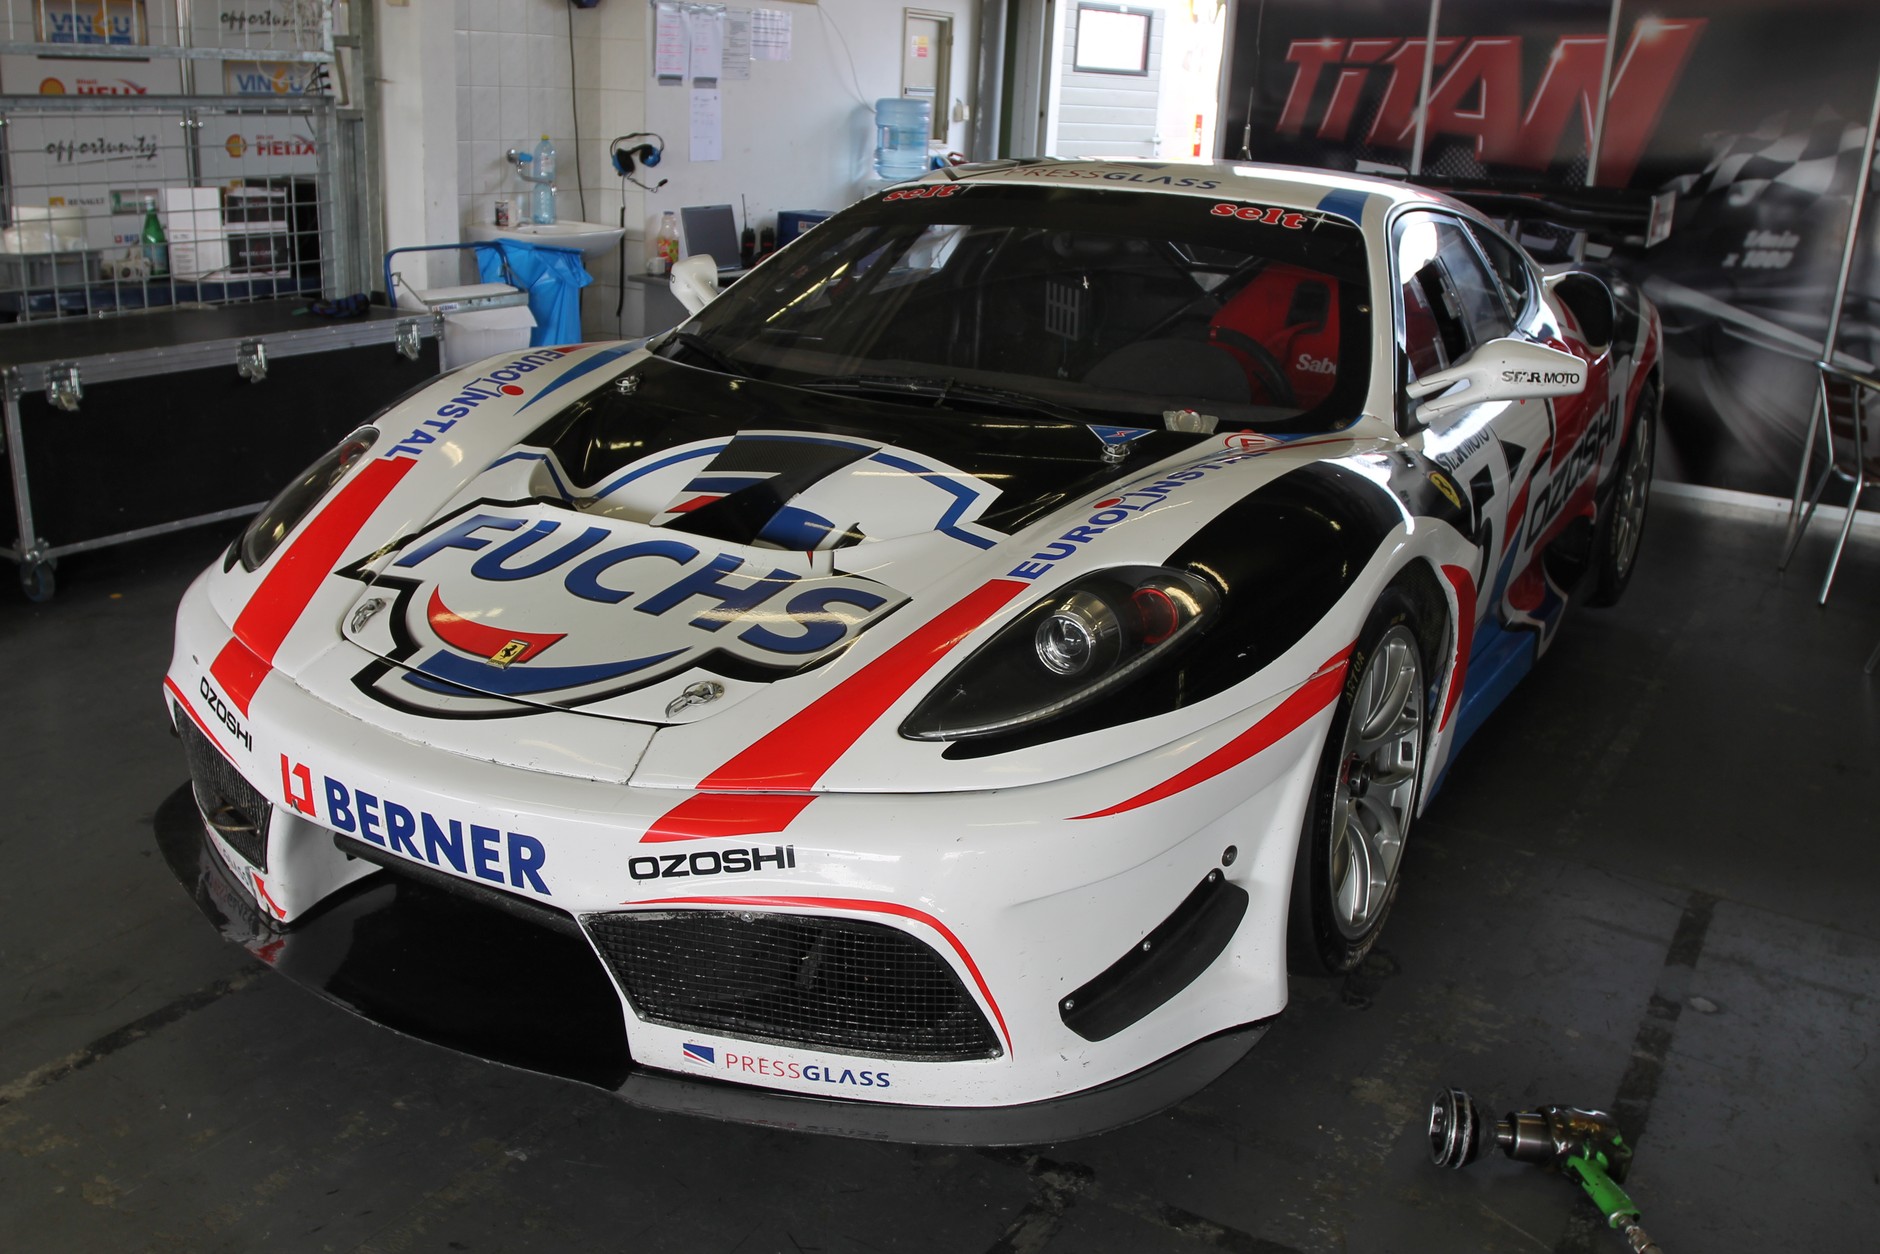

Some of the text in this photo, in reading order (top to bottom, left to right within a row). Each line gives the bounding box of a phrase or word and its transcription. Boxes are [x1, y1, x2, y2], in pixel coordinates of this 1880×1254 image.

[1210, 203, 1308, 230] selt
[1544, 372, 1580, 385] MOTO
[393, 513, 888, 655] FUCHS
[199, 676, 253, 752] OZOSHI
[323, 775, 553, 897] BERNER
[628, 845, 796, 881] OZOSHI
[726, 1052, 892, 1088] PRESSGLASS
